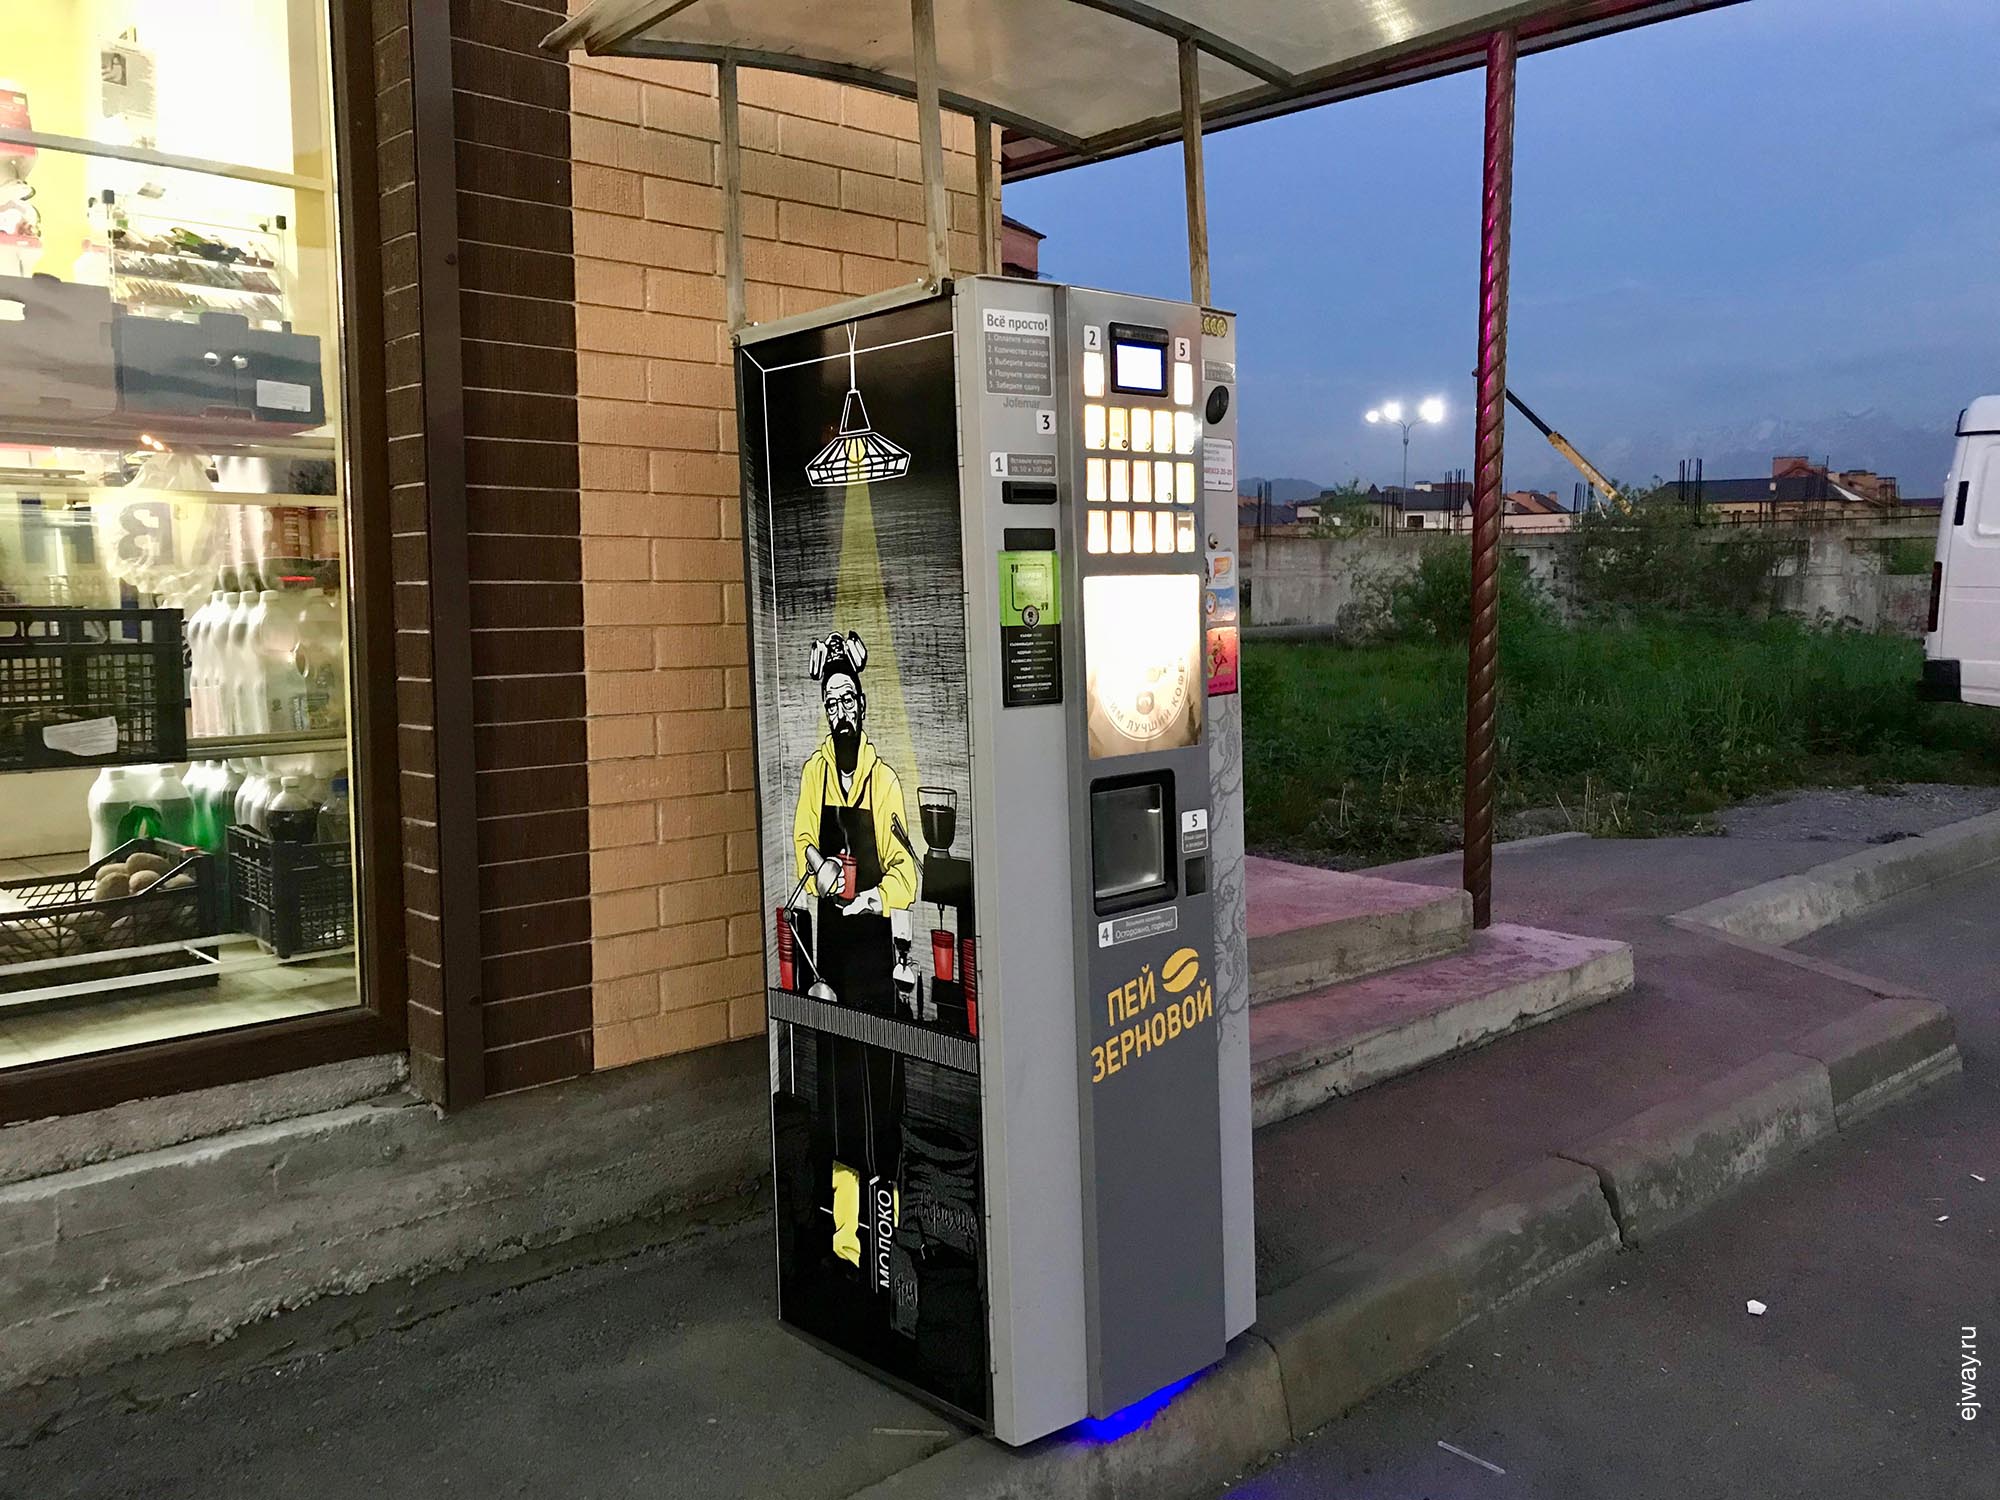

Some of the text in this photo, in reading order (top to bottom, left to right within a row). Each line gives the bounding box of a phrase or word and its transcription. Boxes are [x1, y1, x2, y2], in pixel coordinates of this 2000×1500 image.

[987, 313, 1048, 331] Всё просто!
[1088, 330, 1096, 346] 2
[1179, 342, 1186, 356] 5
[1042, 414, 1050, 430] 3
[995, 456, 1003, 472] 1
[1191, 813, 1198, 828] 5
[1101, 927, 1110, 942] 4
[1107, 963, 1156, 1027] ПЕЙ
[1090, 977, 1213, 1083] ЗЕРНОВОЙ
